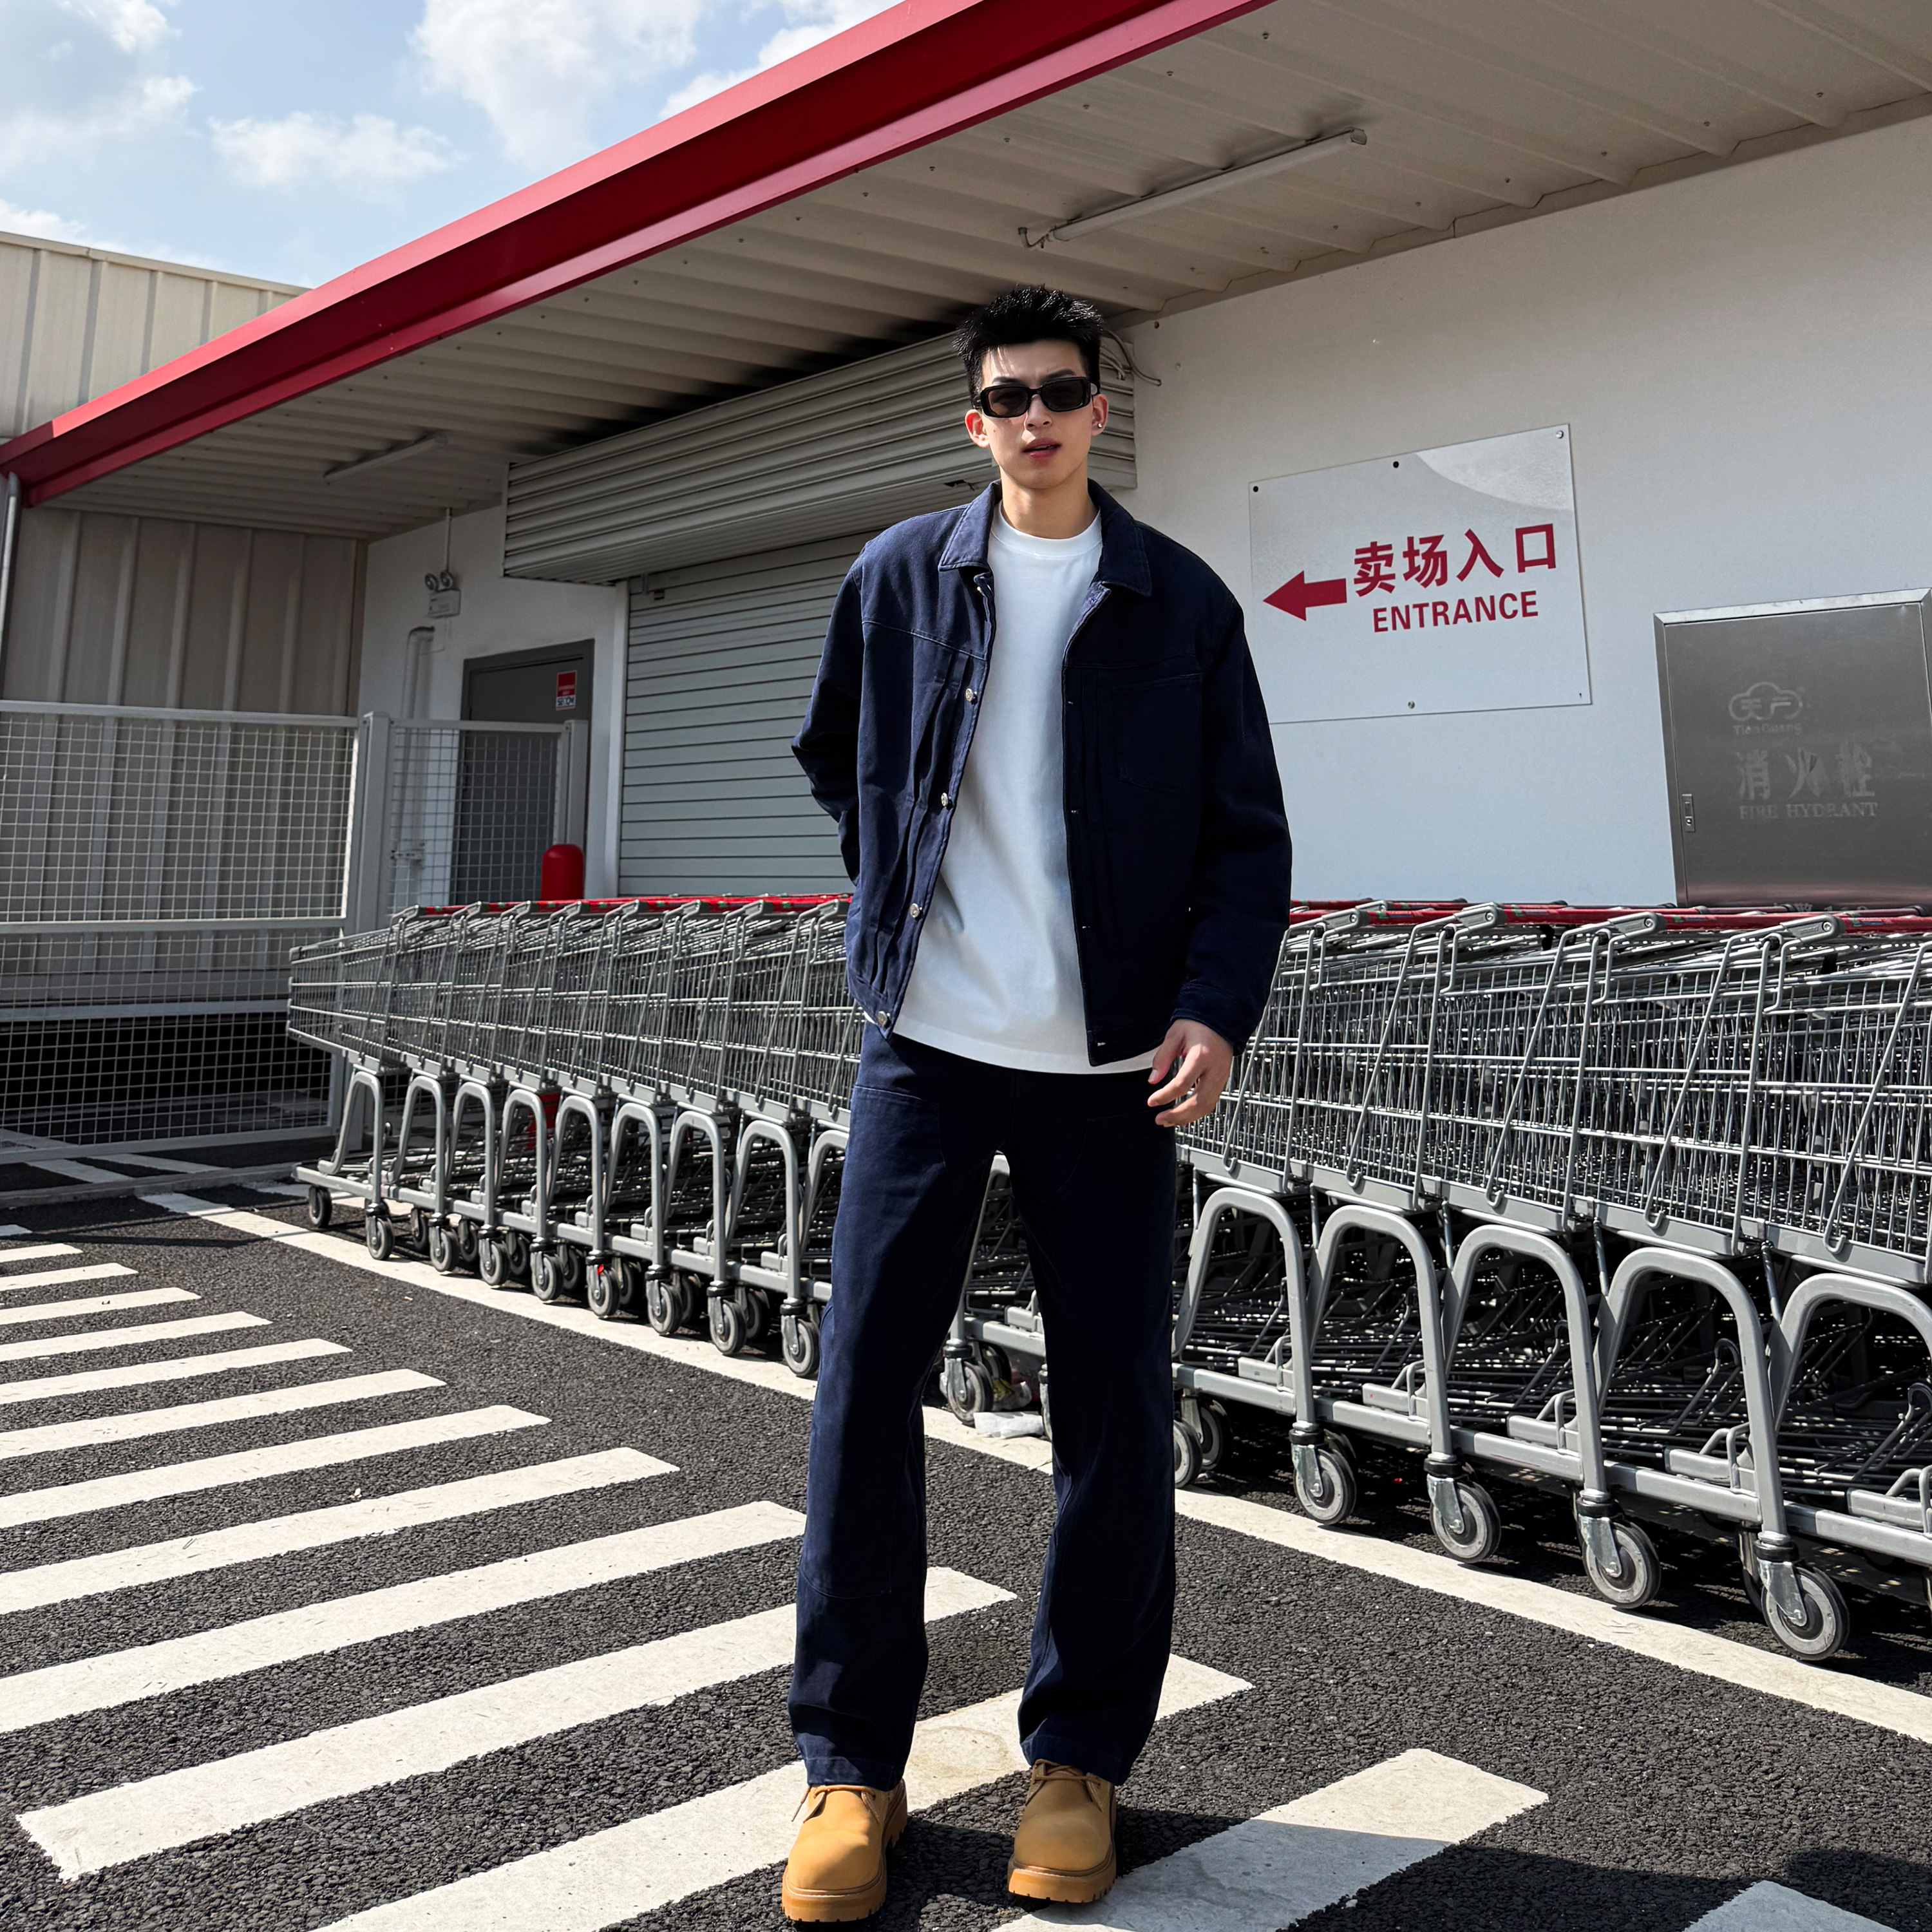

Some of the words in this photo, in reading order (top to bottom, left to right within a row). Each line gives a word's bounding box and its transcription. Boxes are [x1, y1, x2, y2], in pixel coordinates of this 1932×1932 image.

[1354, 523, 1556, 598] 卖场入口
[1372, 590, 1539, 633] ENTRANCE
[1739, 805, 1779, 819] FIRE
[1785, 802, 1878, 818] HYDRANT
